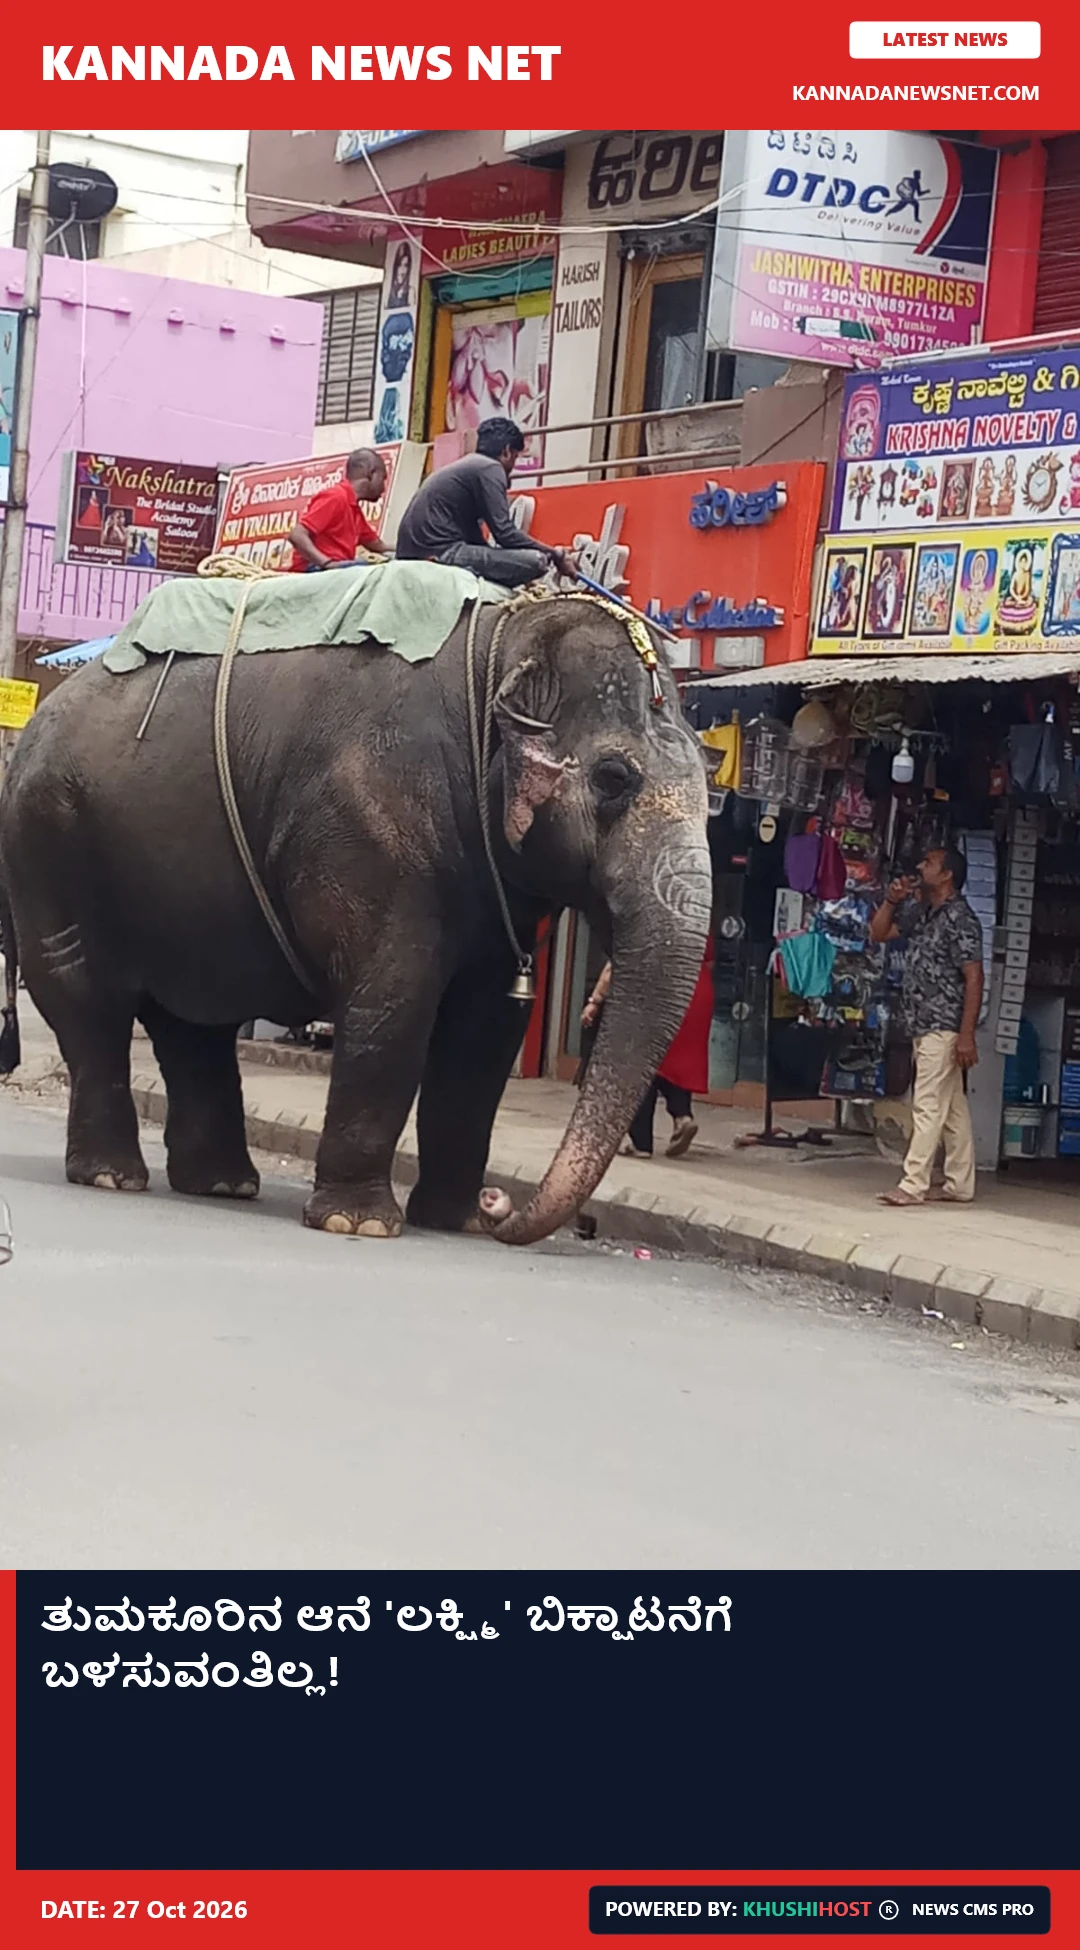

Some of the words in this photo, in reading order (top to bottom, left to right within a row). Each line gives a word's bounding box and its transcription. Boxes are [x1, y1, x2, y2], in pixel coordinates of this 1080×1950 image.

[765, 168, 891, 214] DTDC
[886, 217, 921, 236] Value
[443, 240, 486, 263] LADIES
[488, 234, 539, 256] BEAUTY
[562, 260, 600, 287] HARISH
[751, 249, 853, 288] JASHWITHA
[859, 266, 976, 308] ENTERPRISES
[768, 279, 808, 298] GSTIN
[555, 299, 601, 334] TAILORS
[750, 310, 779, 330] Mob
[783, 300, 822, 316] Branch
[898, 317, 937, 333] Tumkur
[913, 378, 953, 414] ಕೃಷ್ಣ
[1033, 366, 1056, 391] &
[885, 416, 969, 455] KRISHNA
[972, 409, 1061, 448] NOVELTY
[104, 465, 216, 497] Nakshatra
[136, 497, 152, 508] The
[155, 499, 184, 512] Bridal
[186, 503, 216, 515] Studio
[151, 512, 195, 527] Academy
[164, 526, 198, 539] Saloon
[223, 518, 241, 542] SRI
[242, 509, 298, 540] VINAYAKA
